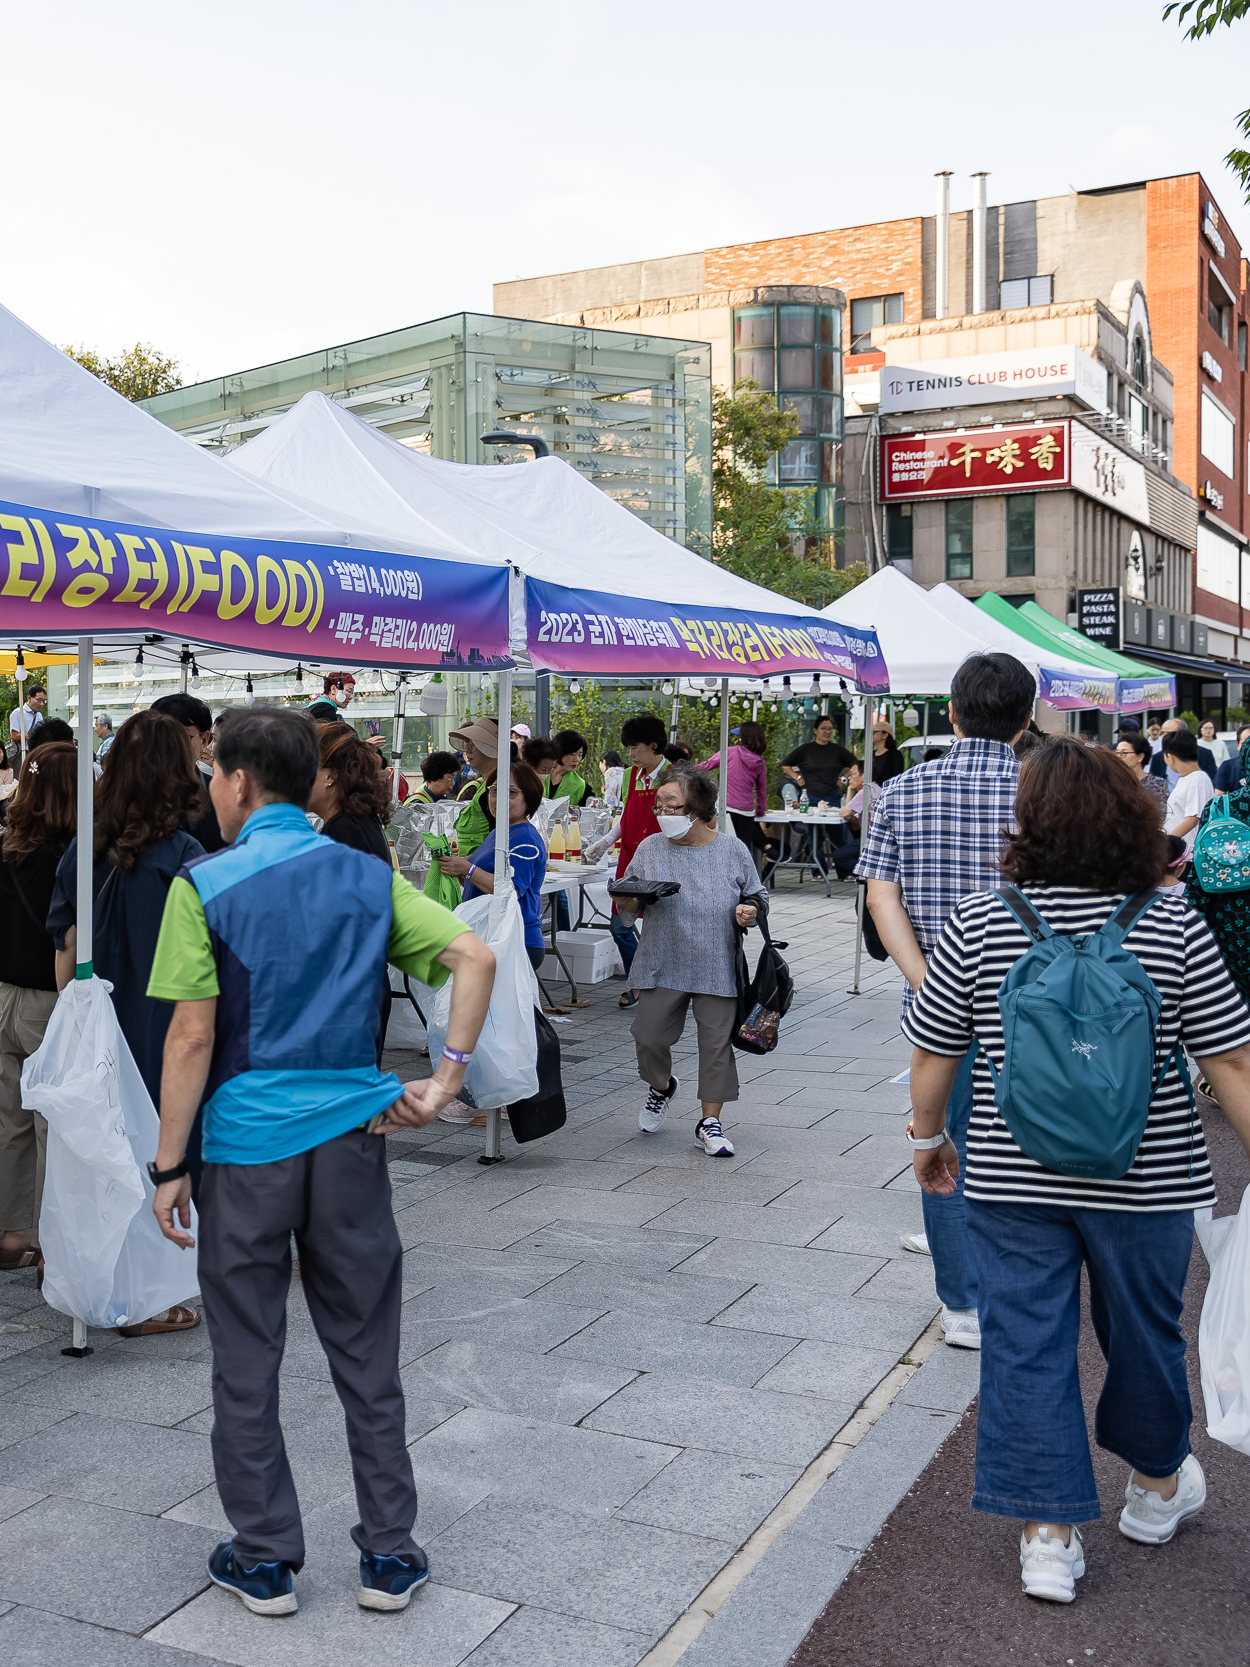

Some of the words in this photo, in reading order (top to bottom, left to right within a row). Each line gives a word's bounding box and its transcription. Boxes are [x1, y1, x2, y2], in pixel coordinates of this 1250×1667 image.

[906, 376, 963, 393] TENNIS
[967, 371, 1008, 386] CLUB
[1012, 363, 1069, 381] HOUSE
[891, 450, 935, 462] Chinese
[950, 434, 1062, 478] 千味香
[891, 457, 949, 472] Restaurant
[1083, 592, 1115, 603] PIZZA
[1082, 603, 1117, 614] PASTA
[1082, 614, 1117, 625] STEAK
[537, 609, 585, 643] 2023
[583, 613, 618, 646] 군자
[1085, 626, 1114, 636] WINE
